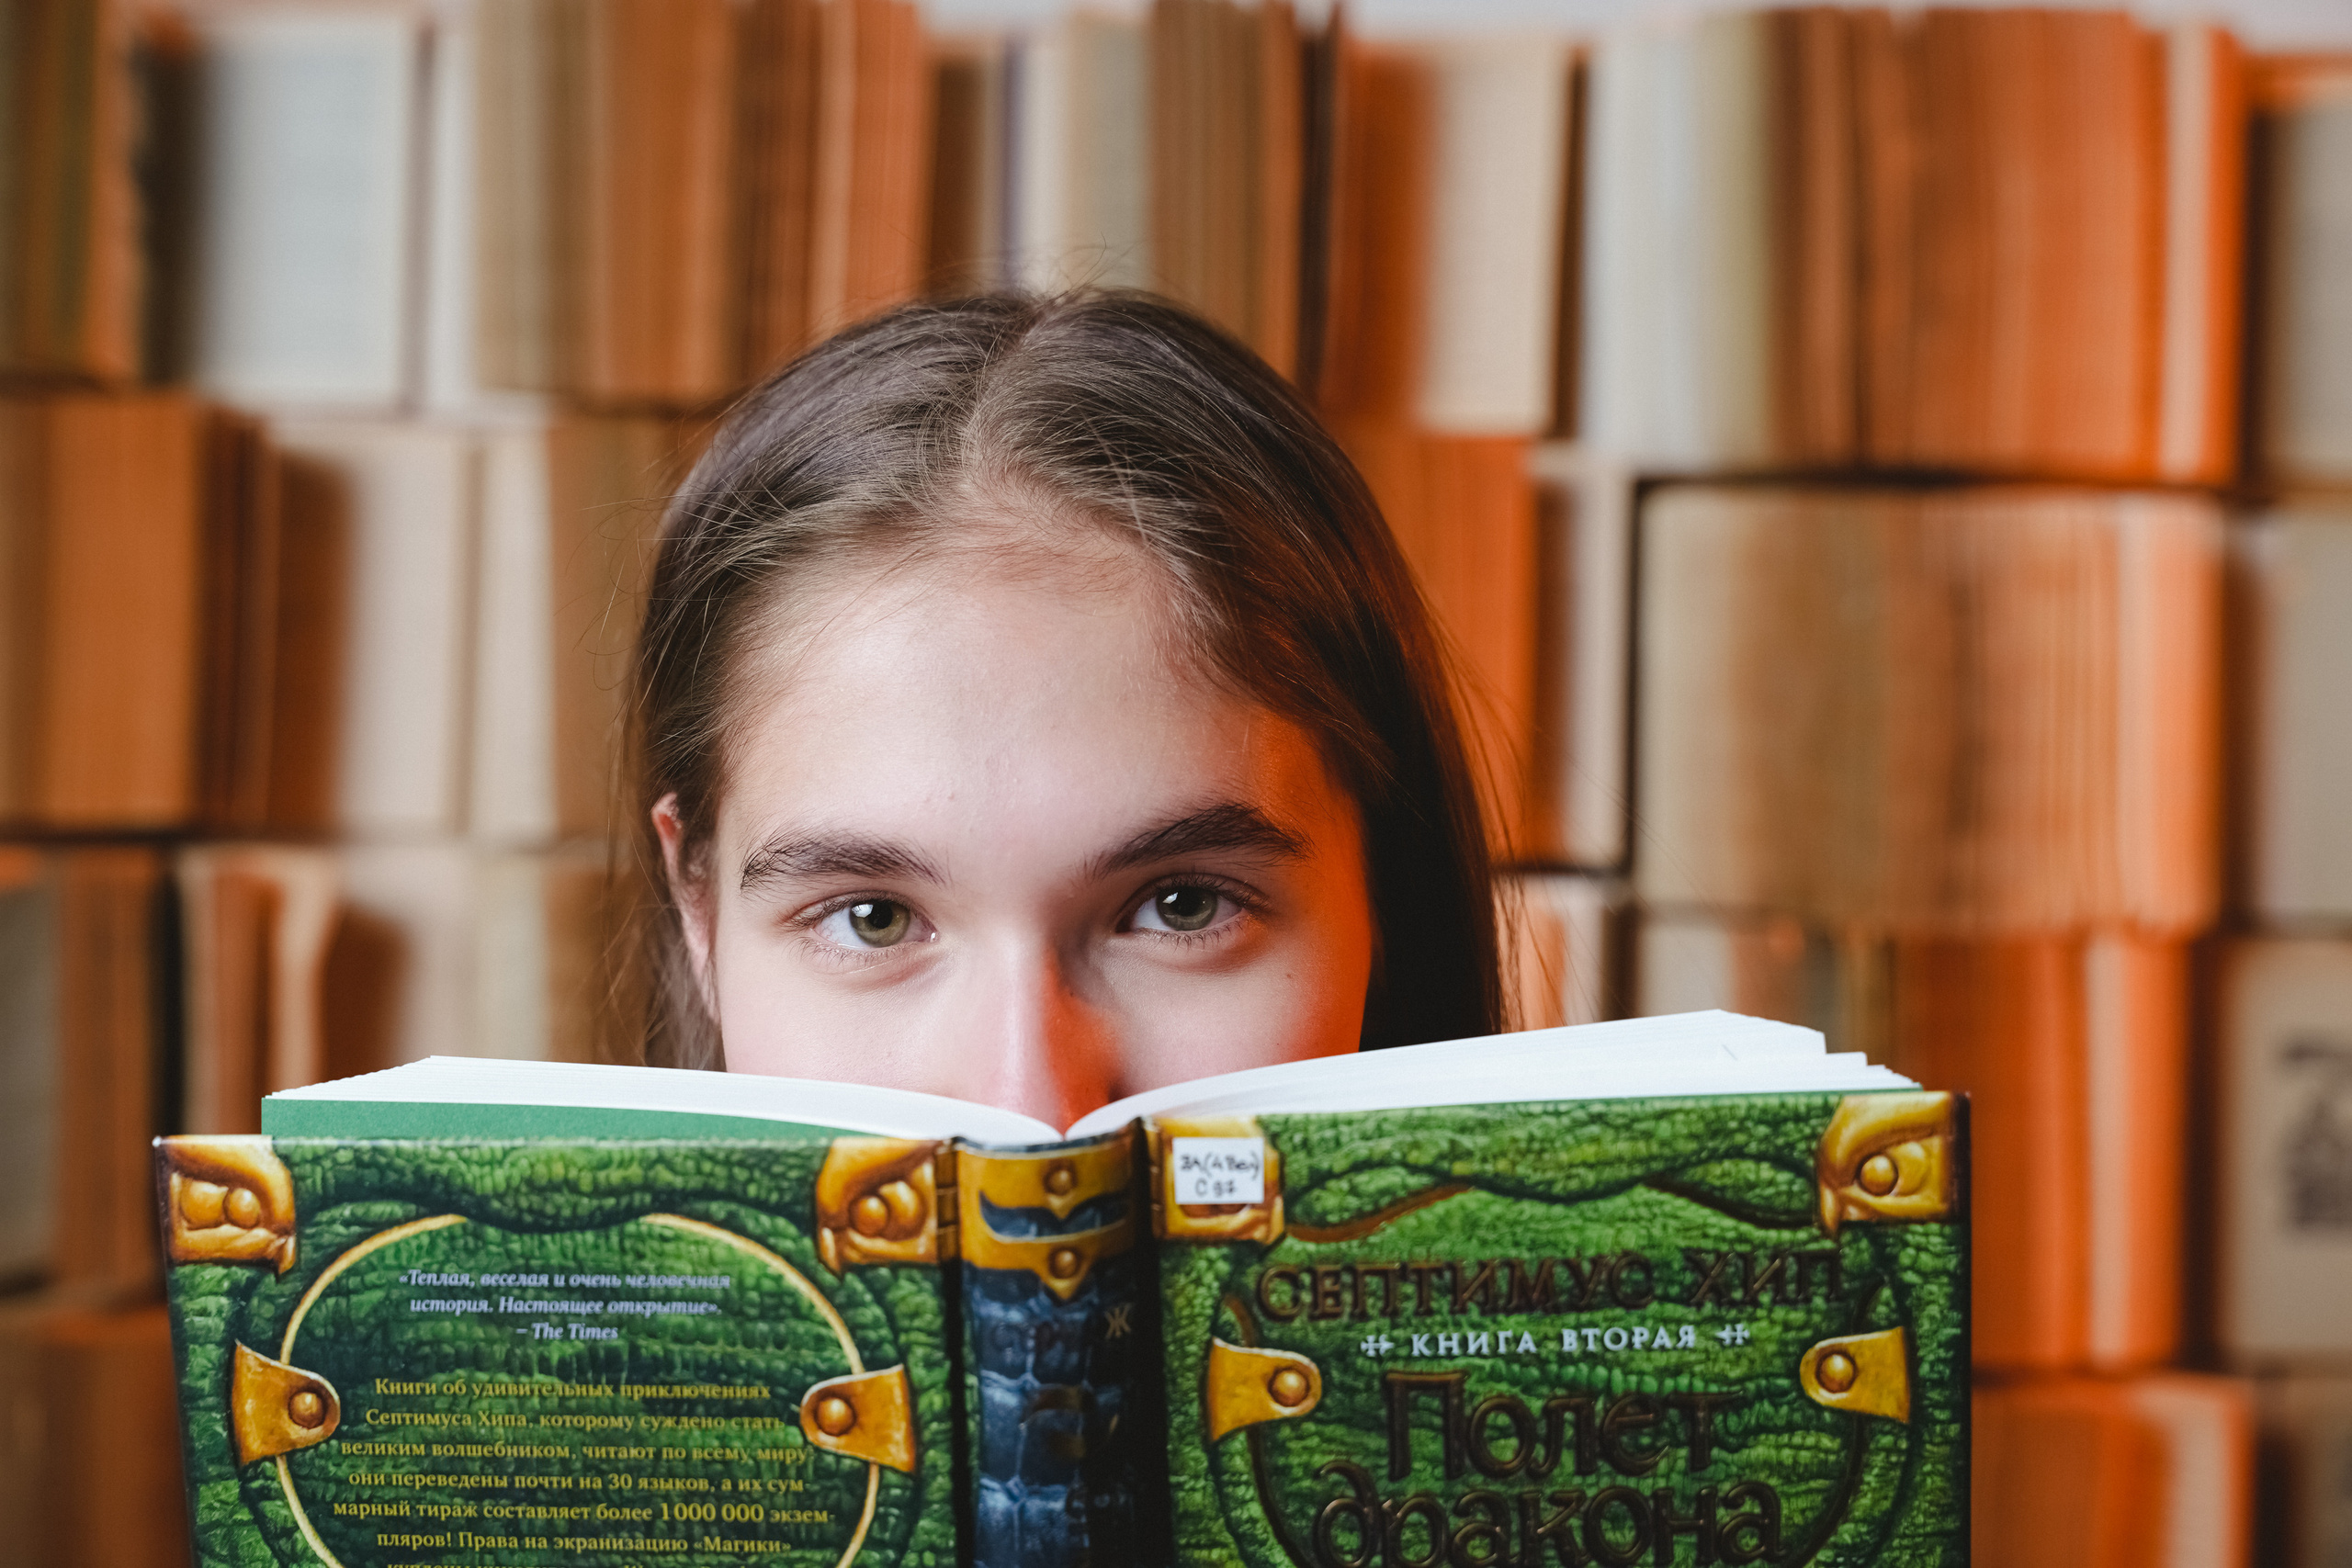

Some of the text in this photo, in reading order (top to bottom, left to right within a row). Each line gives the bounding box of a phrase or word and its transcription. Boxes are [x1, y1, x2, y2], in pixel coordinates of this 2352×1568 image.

[399, 1269, 730, 1289] «Теплая, веселая и очень человечная
[1256, 1247, 1843, 1323] СЕПТИМУС ХИП
[410, 1296, 722, 1319] история. Настоящее открытие».
[532, 1322, 563, 1339] The
[567, 1322, 618, 1340] Times
[1410, 1325, 1696, 1358] КНИГА ВТОРАЯ
[375, 1378, 771, 1401] Книги об удивительных приключениях
[366, 1408, 785, 1432] Септимуса Хипа, которому суждено стать
[1384, 1368, 1744, 1482] Полет
[341, 1442, 425, 1456] великим
[432, 1440, 577, 1460] волшебником,
[582, 1446, 657, 1460] читают
[662, 1446, 686, 1460] по
[692, 1447, 750, 1463] всему
[348, 1472, 386, 1486] они
[391, 1473, 508, 1490] переведены
[514, 1475, 573, 1489] почти
[579, 1476, 602, 1490] на
[607, 1473, 632, 1490] 30
[638, 1477, 716, 1493] языков,
[721, 1478, 732, 1491] а
[738, 1478, 763, 1492] их
[334, 1501, 411, 1519] марный
[415, 1504, 478, 1521] тираж
[482, 1505, 591, 1519] составляет
[597, 1502, 653, 1521] более
[769, 1508, 836, 1524] экзем-
[1313, 1459, 1786, 1568] дракона
[377, 1531, 792, 1553] пляров! Права на экранизацию «Магики»
